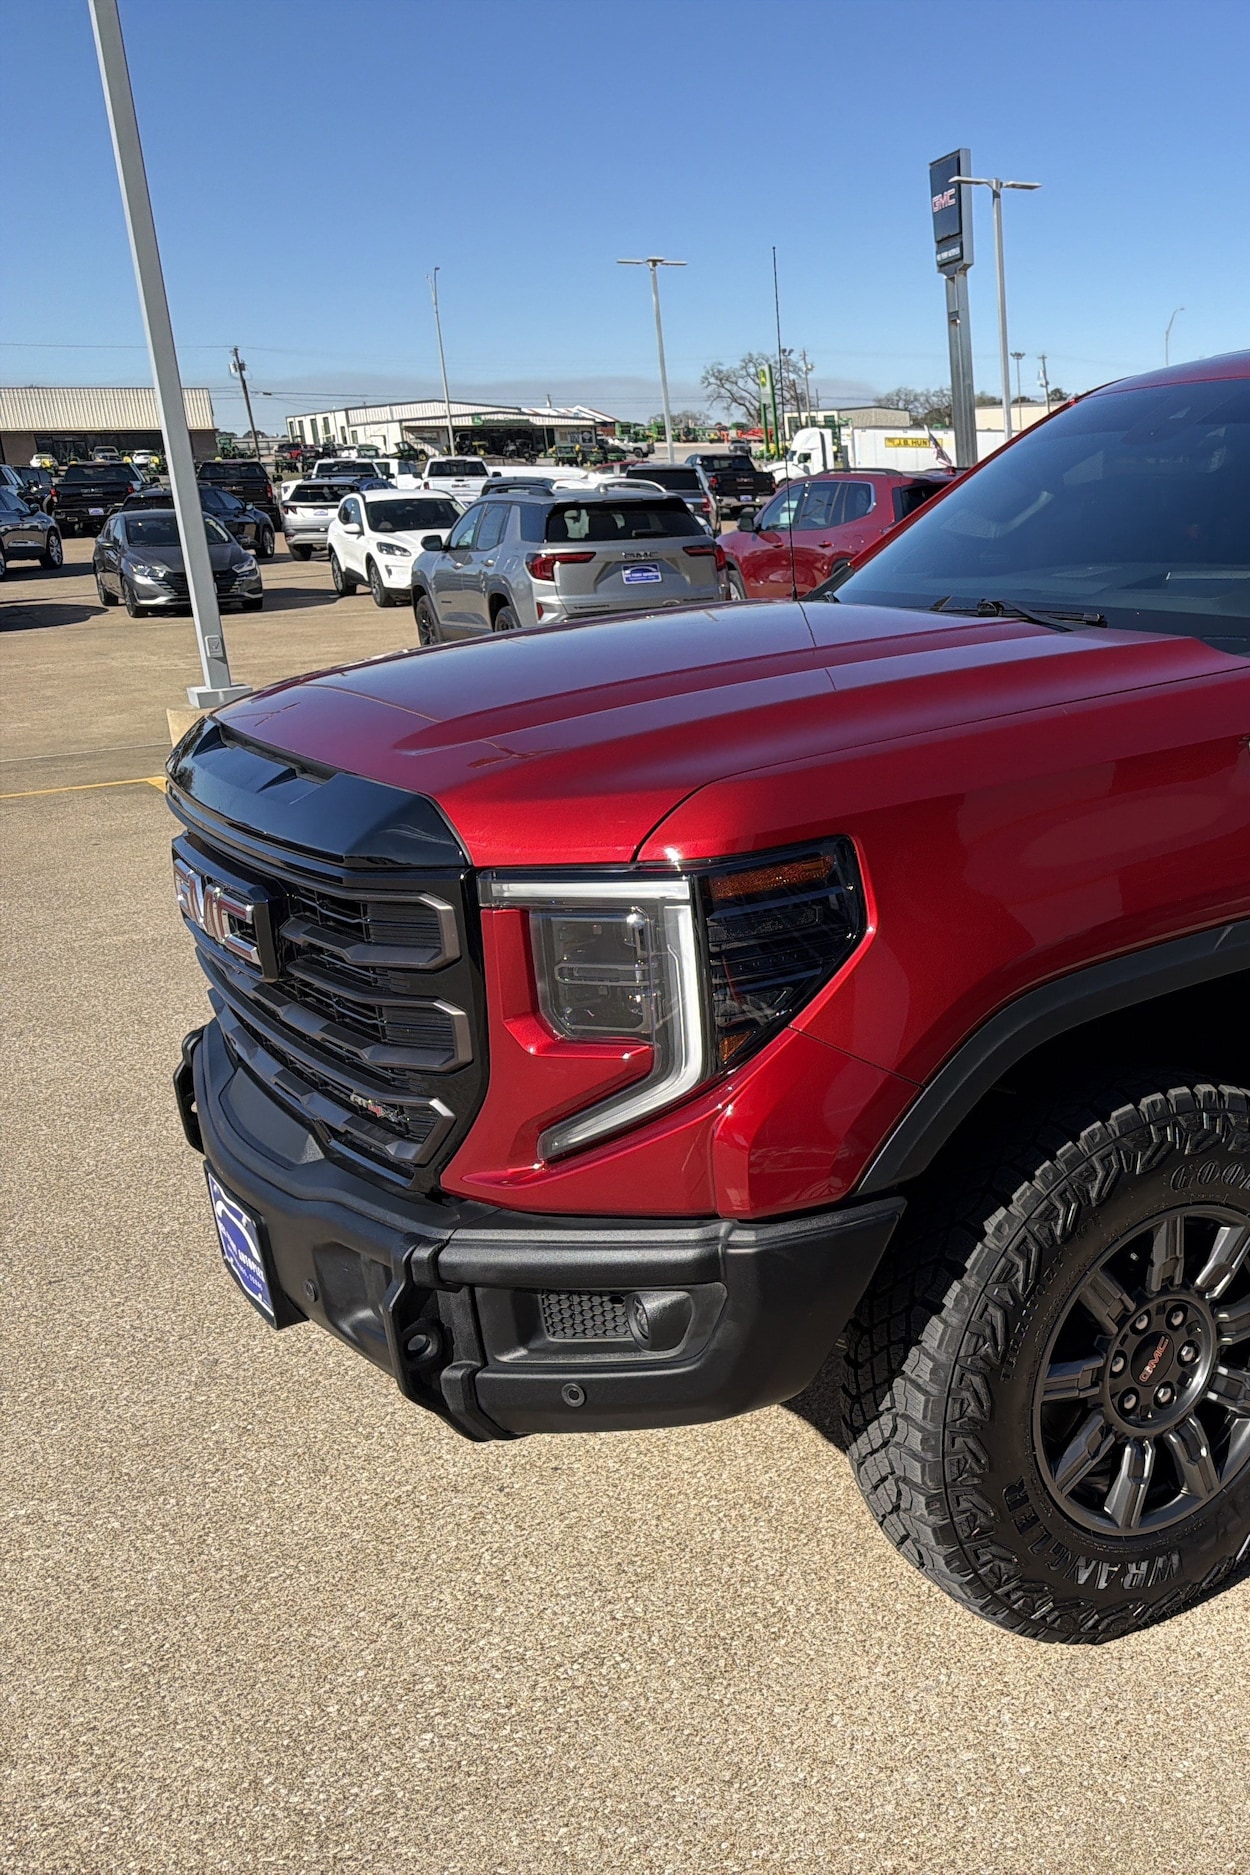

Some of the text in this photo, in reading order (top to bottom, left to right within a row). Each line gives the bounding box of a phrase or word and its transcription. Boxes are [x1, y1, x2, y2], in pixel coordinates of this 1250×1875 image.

[932, 188, 956, 213] GMC
[623, 551, 659, 560] GMC
[174, 858, 262, 966] GMC
[1139, 1335, 1169, 1383] GMC
